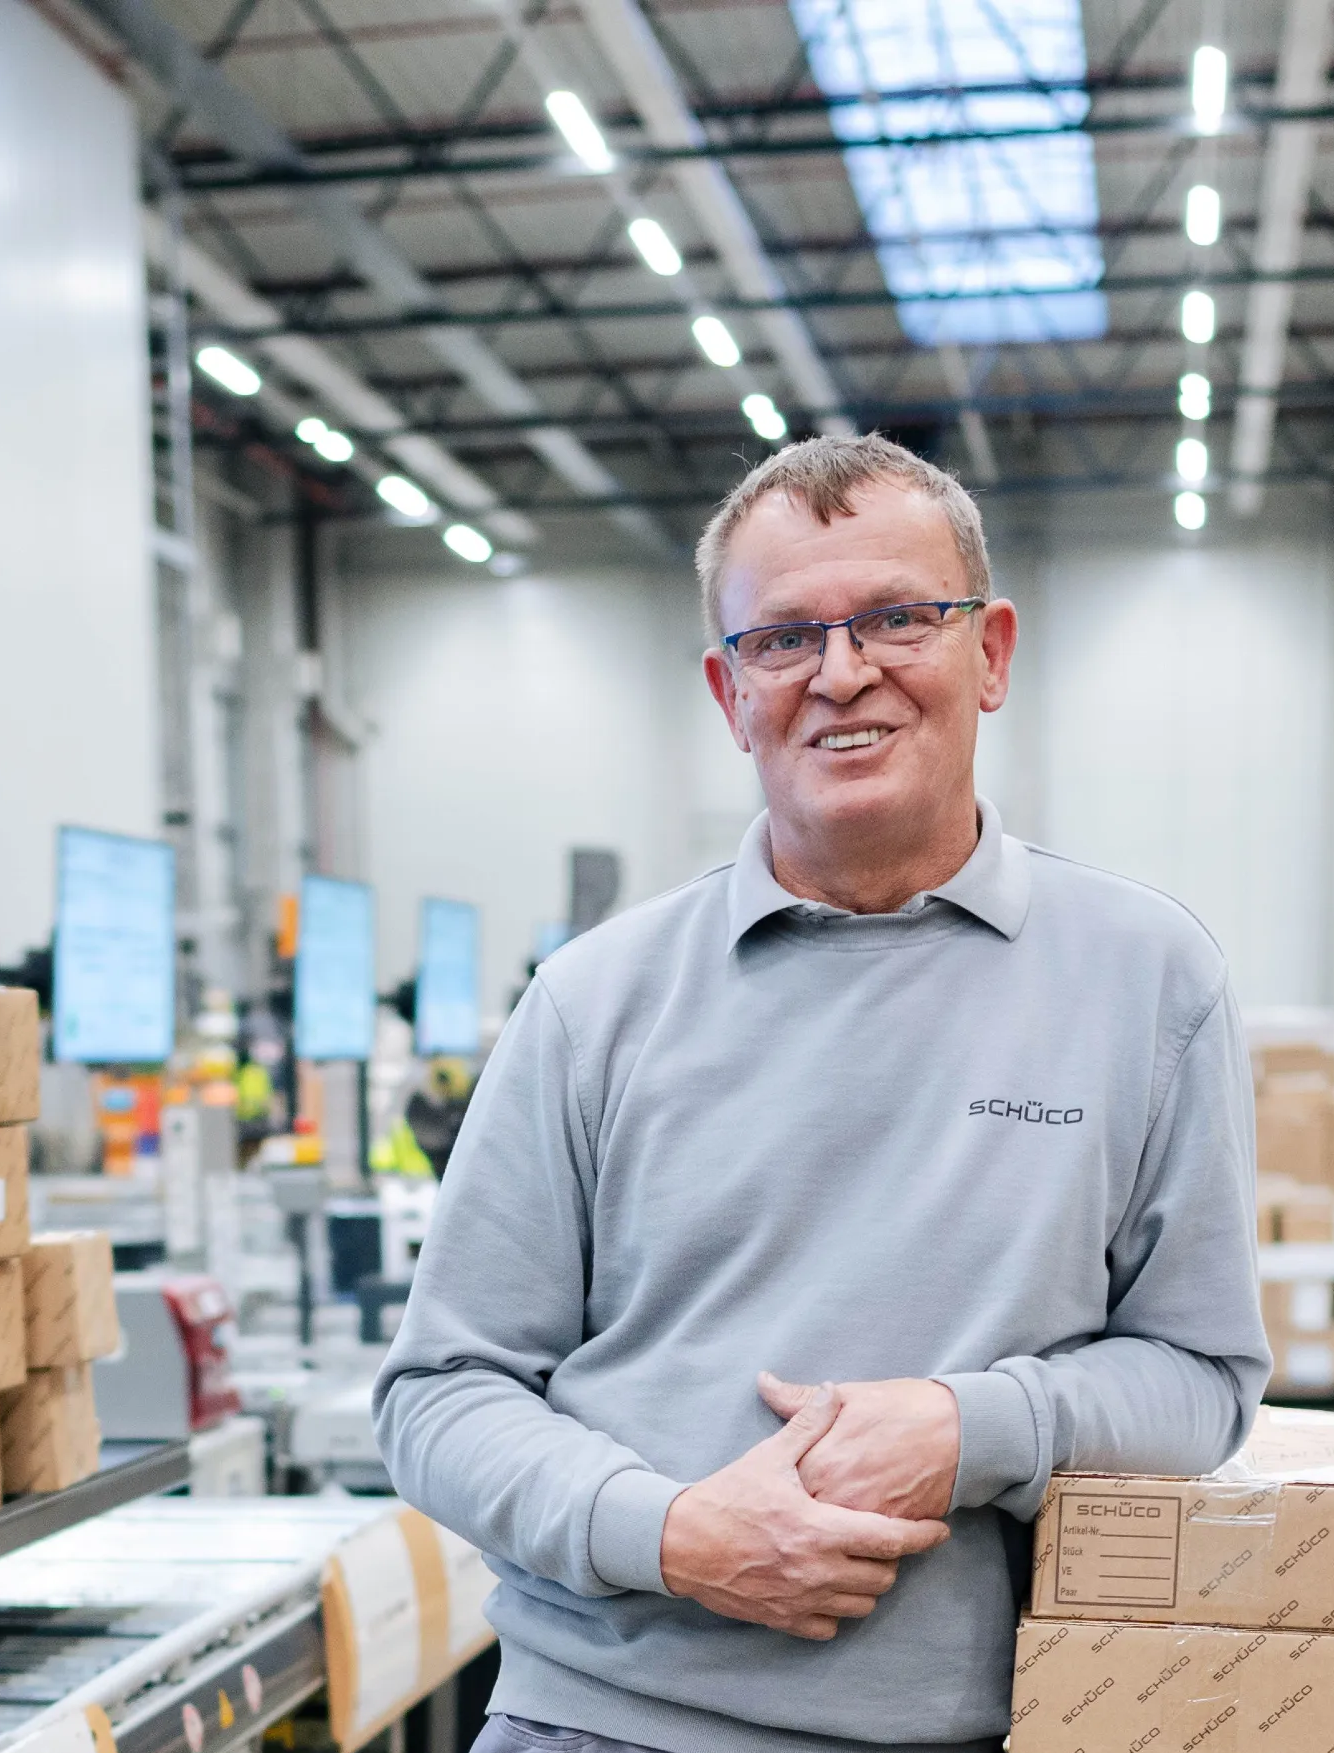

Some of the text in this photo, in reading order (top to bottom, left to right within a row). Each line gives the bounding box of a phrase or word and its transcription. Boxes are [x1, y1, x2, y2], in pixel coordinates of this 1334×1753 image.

[968, 1099, 1084, 1125] SCHÜCO
[1077, 1502, 1161, 1518] SCHÜCO
[1063, 1526, 1101, 1536] Artikel-Nr.
[1062, 1547, 1083, 1556] Stück
[1275, 1527, 1330, 1577] SCHÜCO
[1061, 1566, 1072, 1575] VE
[1060, 1587, 1078, 1596] Paar
[1137, 1656, 1190, 1703] SCHÜCO
